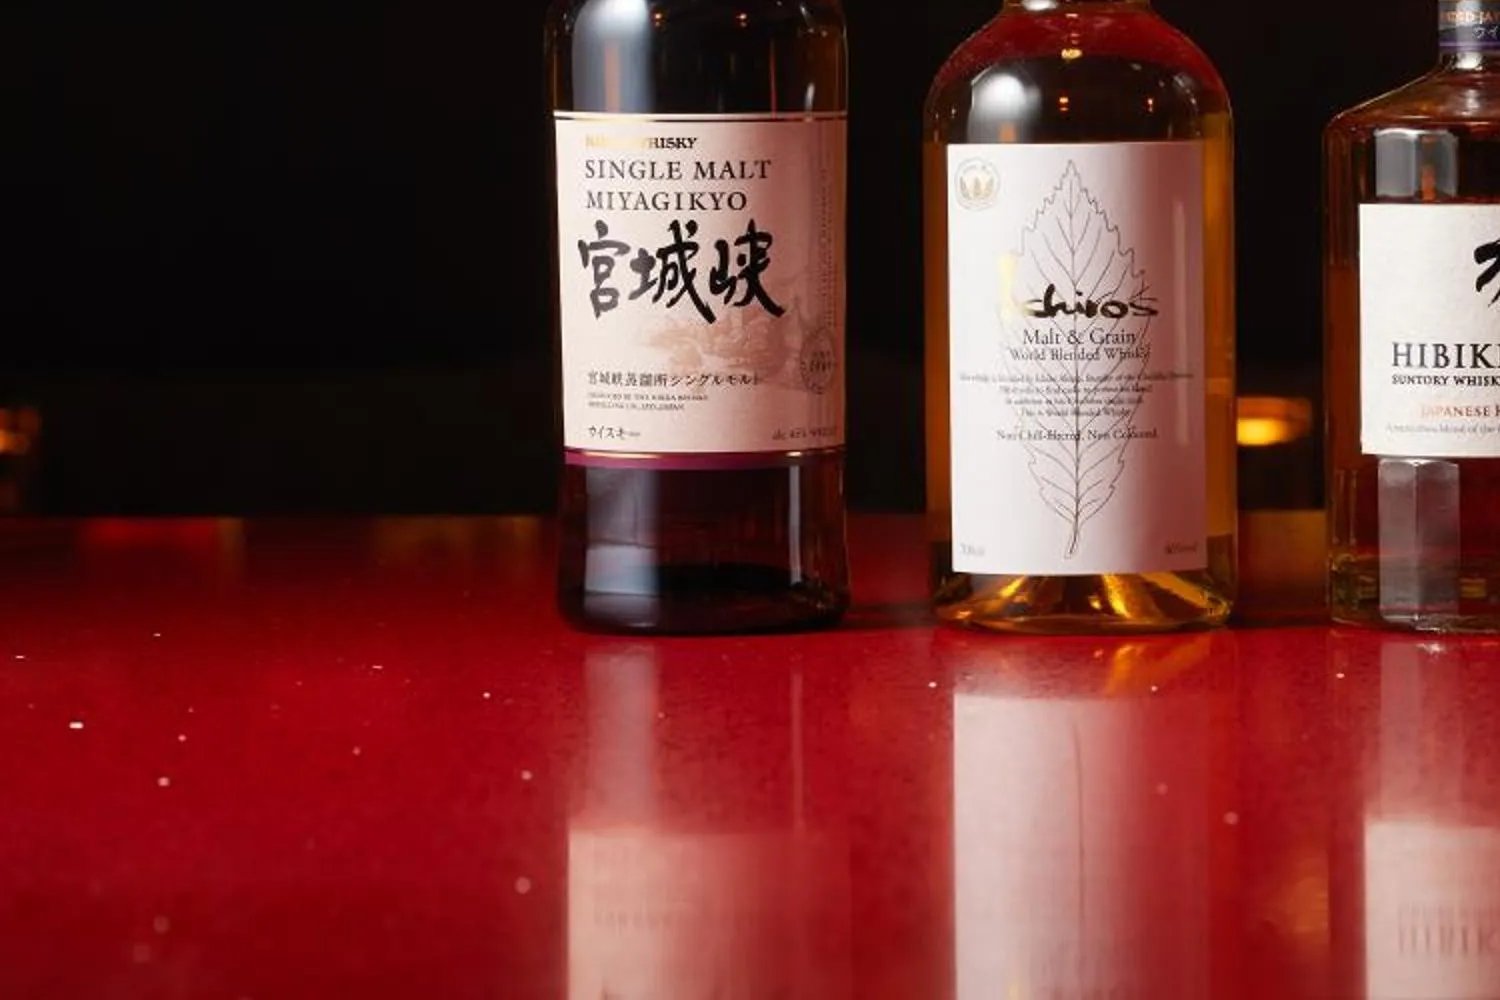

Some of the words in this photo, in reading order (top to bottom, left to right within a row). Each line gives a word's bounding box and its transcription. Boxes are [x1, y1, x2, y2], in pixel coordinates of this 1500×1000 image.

[585, 159, 683, 181] SINGLE
[693, 160, 772, 181] MALT
[586, 190, 748, 211] MIYAGIKYO
[1023, 329, 1061, 345] Malt
[1067, 329, 1083, 346] &
[1090, 328, 1137, 346] Grain
[1391, 374, 1449, 386] SUNTORY
